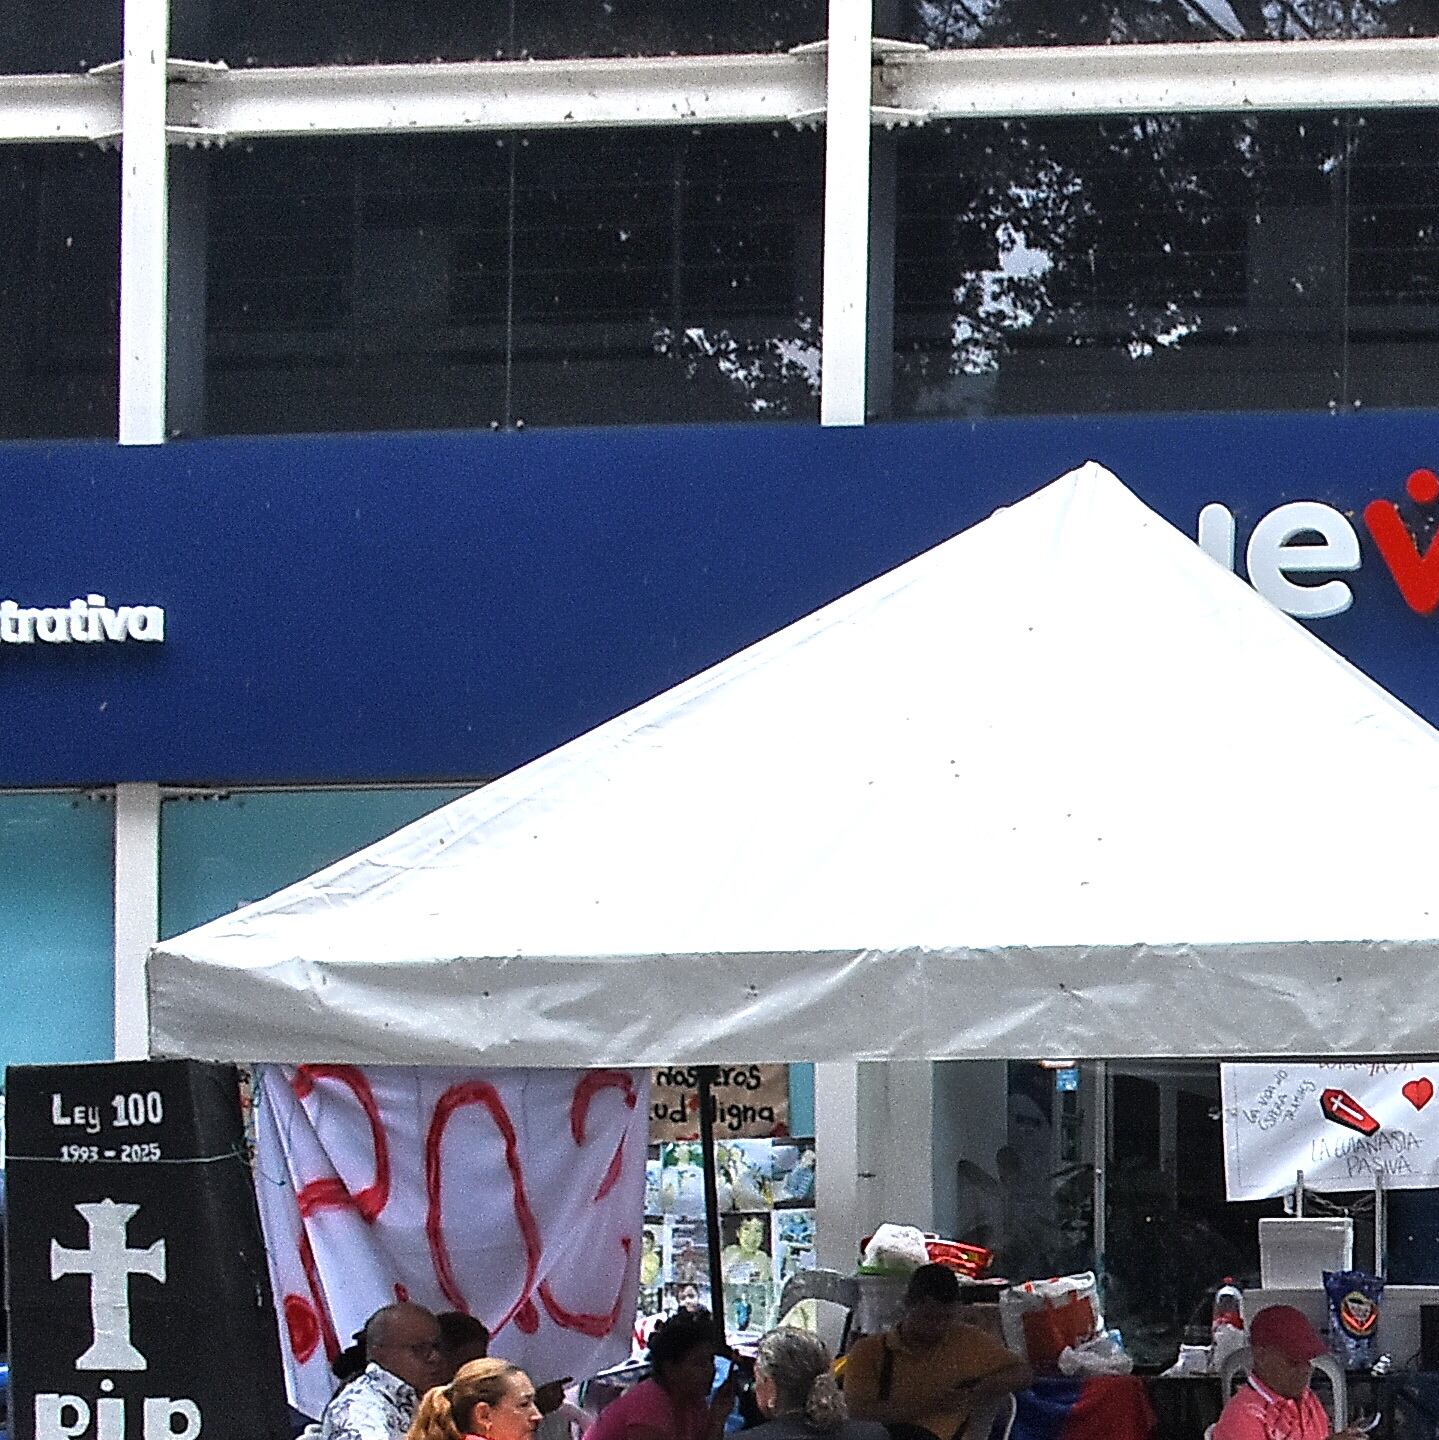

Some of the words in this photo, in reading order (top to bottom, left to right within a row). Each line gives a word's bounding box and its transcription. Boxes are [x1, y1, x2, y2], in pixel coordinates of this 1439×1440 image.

[0, 593, 165, 643] trativa
[111, 1091, 163, 1127] 100
[649, 1093, 687, 1123] ud
[60, 1144, 99, 1163] 1993
[120, 1143, 162, 1163] 2025
[1346, 1155, 1414, 1178] PASIVA
